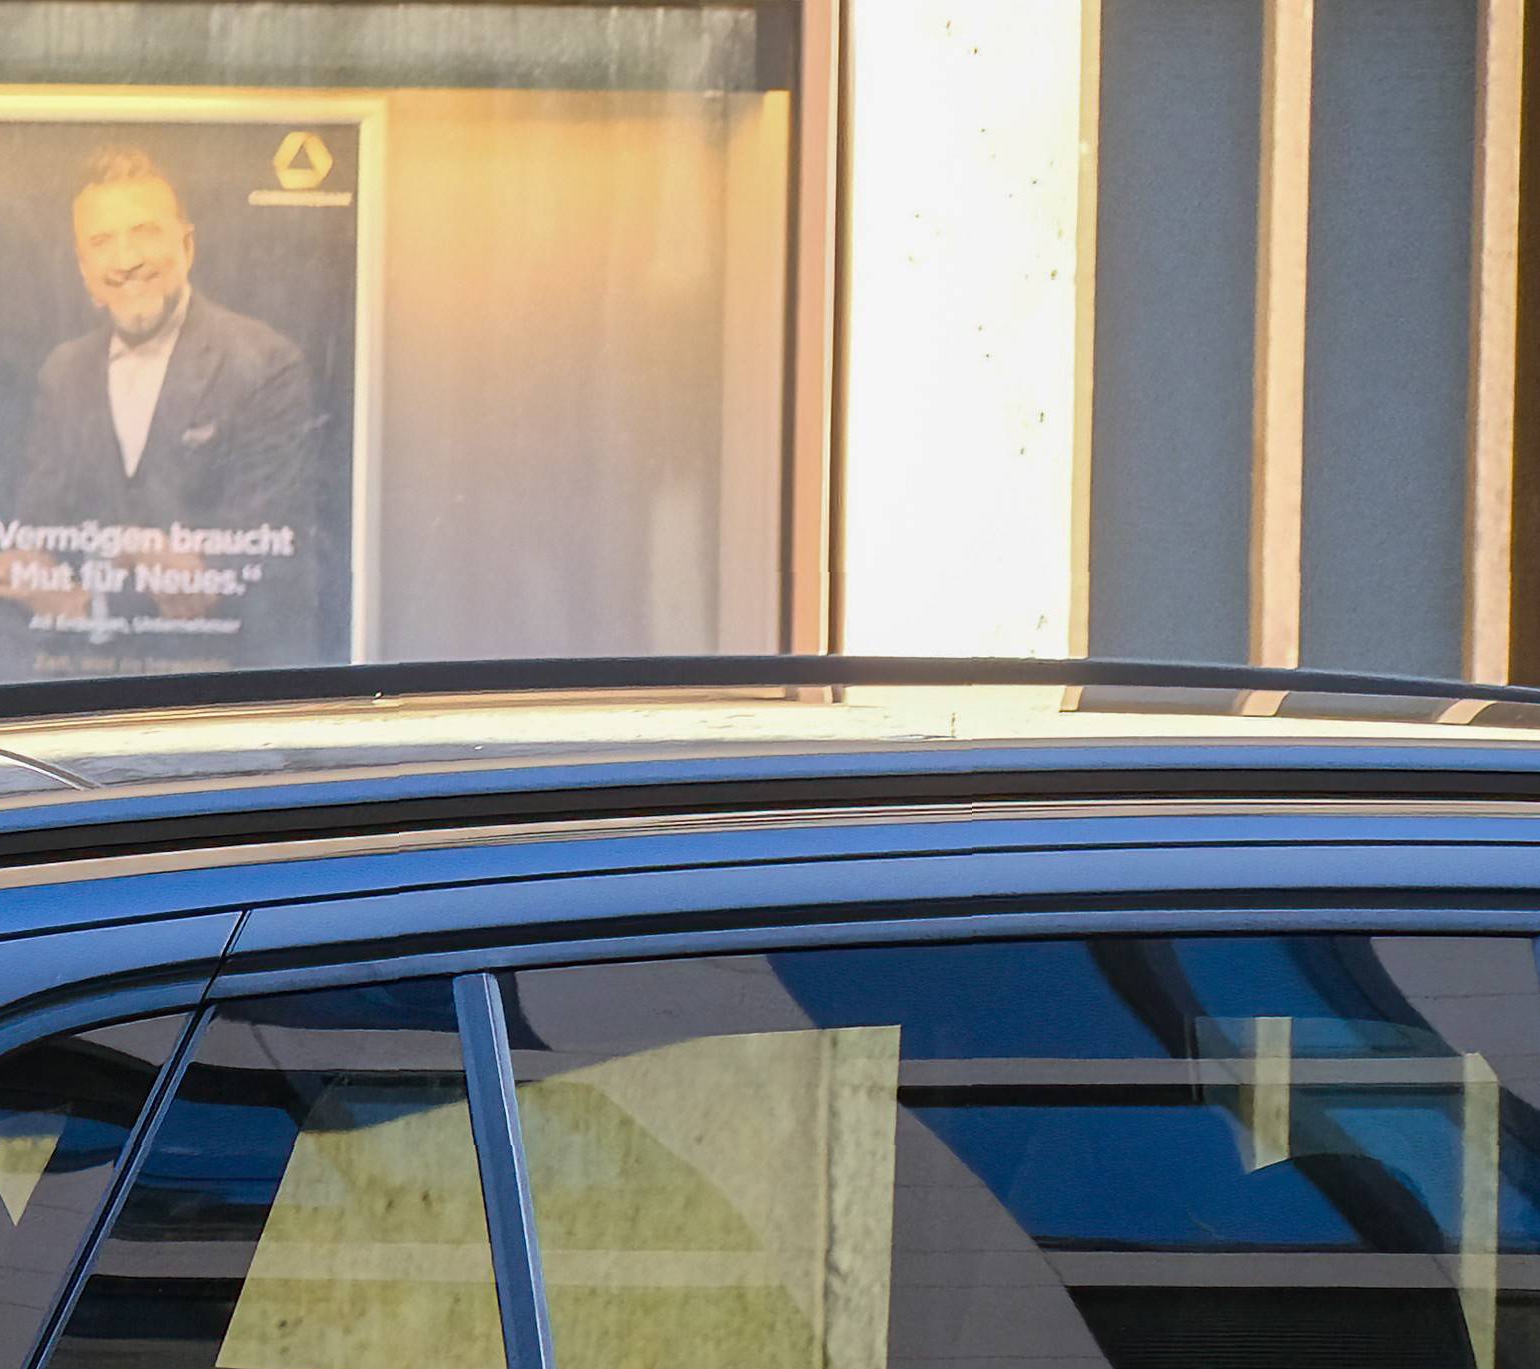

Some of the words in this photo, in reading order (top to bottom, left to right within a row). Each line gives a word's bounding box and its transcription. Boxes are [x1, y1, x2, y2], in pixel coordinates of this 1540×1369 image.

[169, 521, 295, 556] braucht
[10, 560, 73, 592] Mut
[80, 559, 128, 593] für
